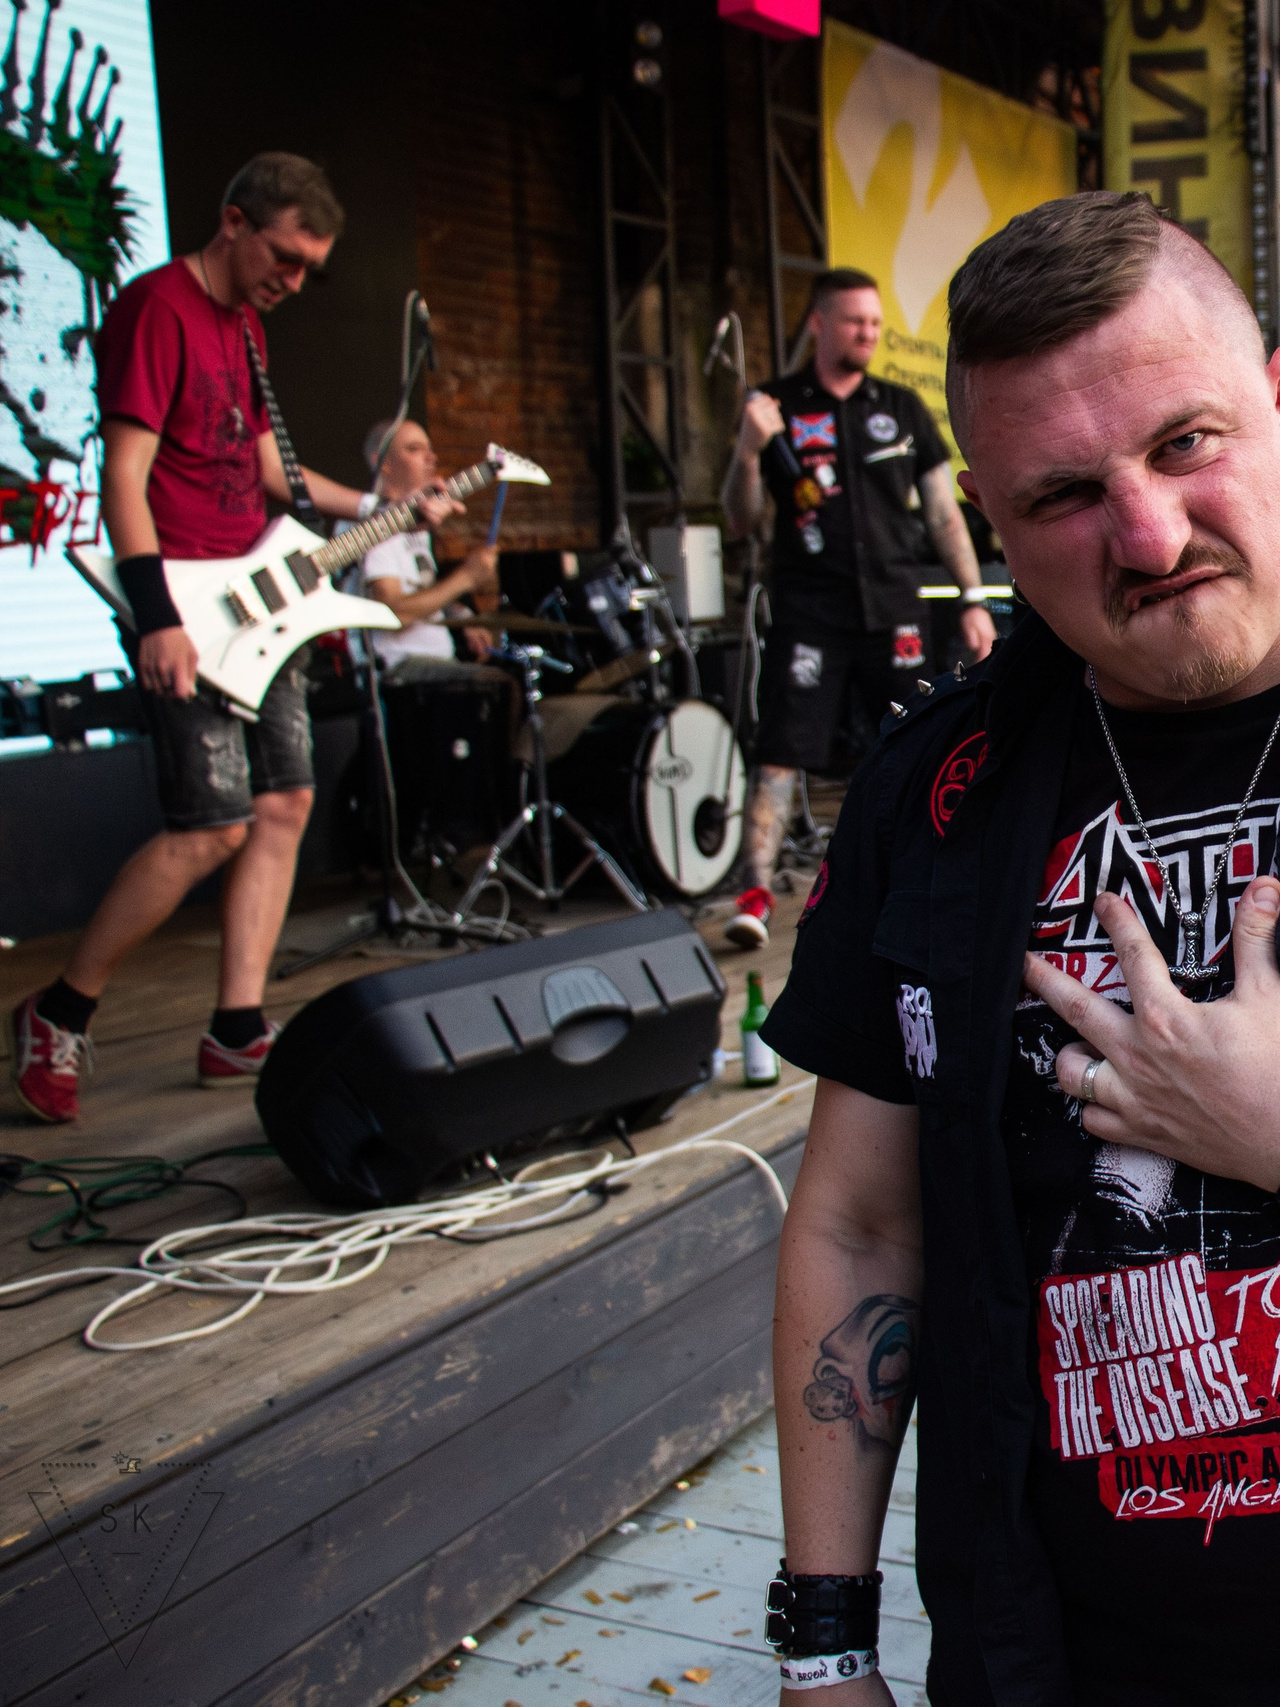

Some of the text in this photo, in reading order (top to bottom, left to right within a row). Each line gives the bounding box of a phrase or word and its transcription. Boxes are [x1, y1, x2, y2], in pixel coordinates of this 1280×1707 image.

[1045, 1254, 1217, 1370] SPREADING
[1054, 1337, 1262, 1457] THE DISEASE
[1115, 1450, 1251, 1496] OLYMPIC
[1115, 1485, 1186, 1519] LOS
